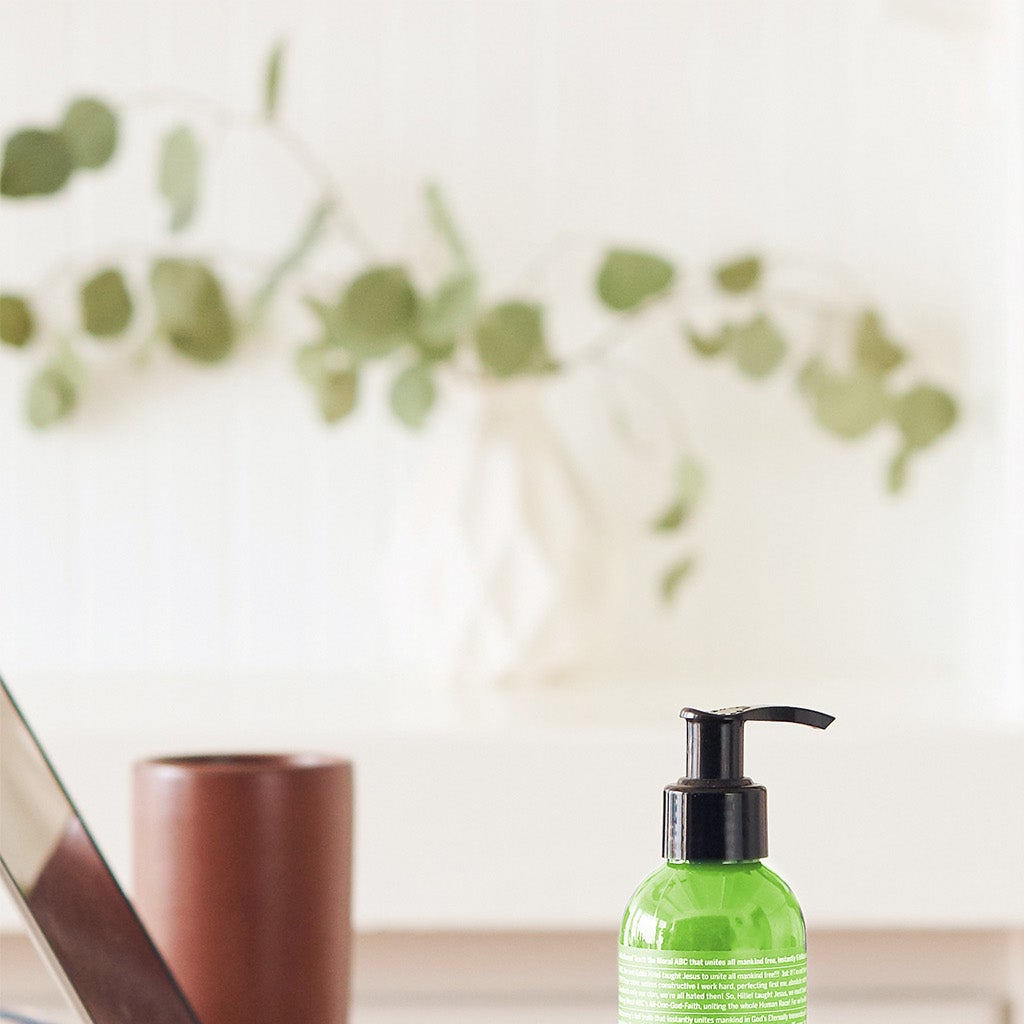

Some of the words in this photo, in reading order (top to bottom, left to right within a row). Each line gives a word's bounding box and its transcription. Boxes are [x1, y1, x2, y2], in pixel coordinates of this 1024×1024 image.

[690, 958, 703, 966] that
[704, 958, 726, 966] unites
[727, 958, 736, 966] all
[737, 957, 764, 965] mankind
[728, 972, 736, 980] all
[737, 982, 768, 991] perfecting
[754, 991, 773, 999] taught
[703, 1003, 726, 1011] uniting
